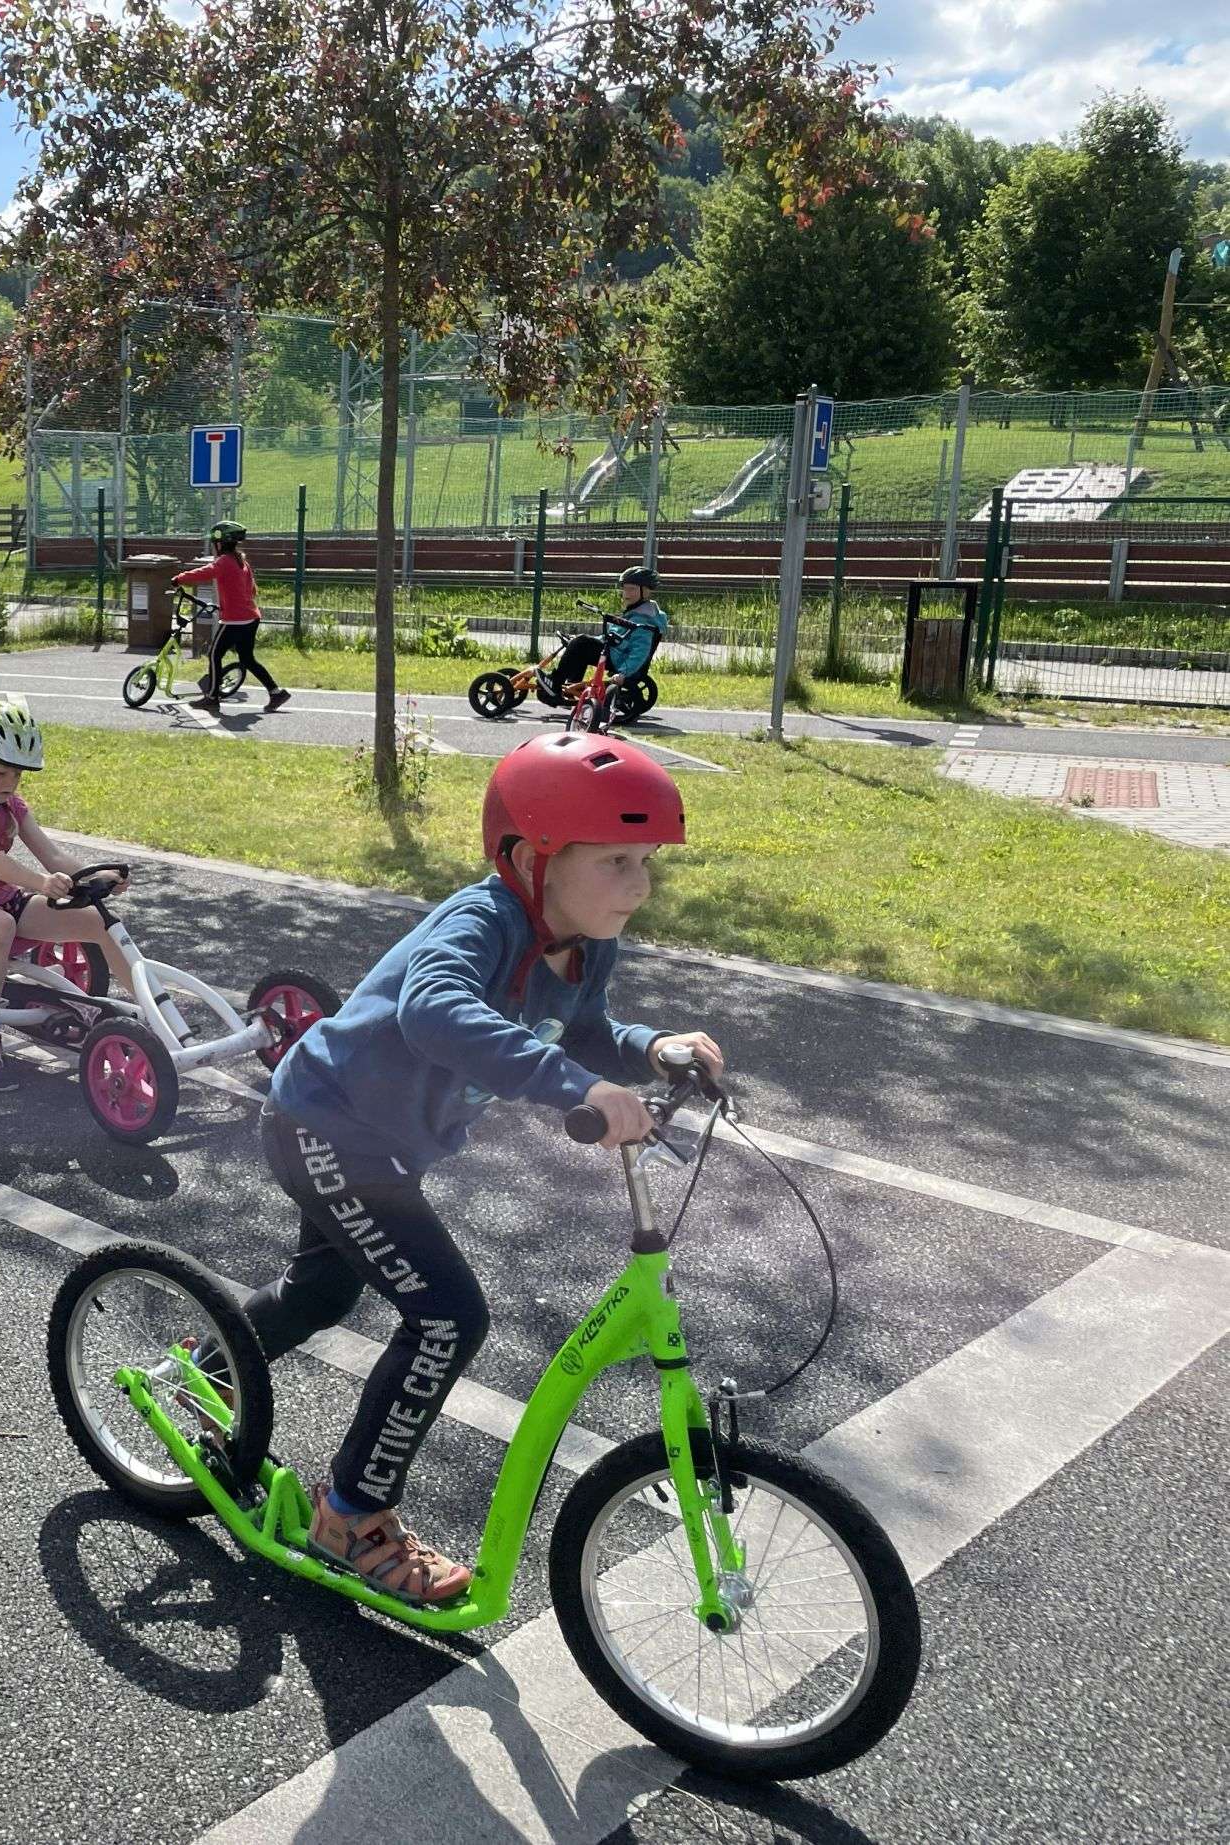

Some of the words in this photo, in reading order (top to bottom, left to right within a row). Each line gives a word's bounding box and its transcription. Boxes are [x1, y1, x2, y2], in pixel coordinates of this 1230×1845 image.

[296, 1127, 347, 1195] CRE
[328, 1197, 429, 1294] ACTIVE
[357, 1400, 427, 1502] ACTIVE
